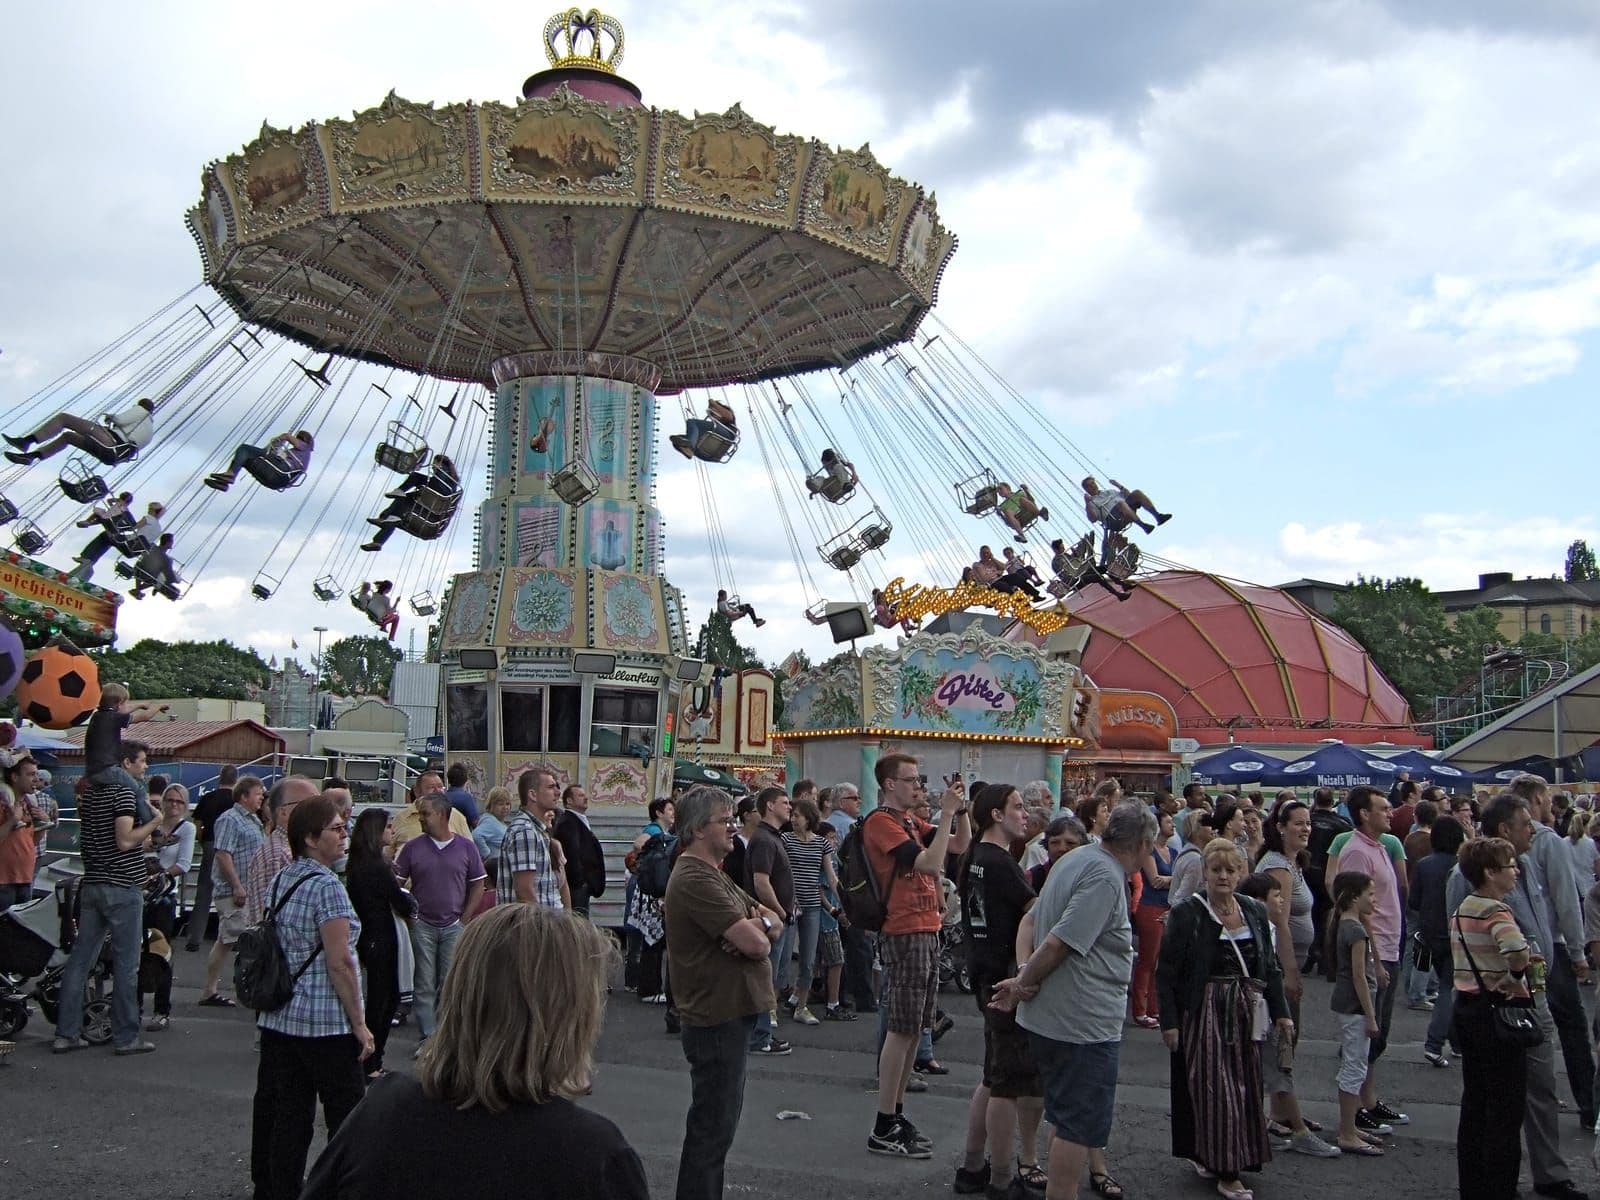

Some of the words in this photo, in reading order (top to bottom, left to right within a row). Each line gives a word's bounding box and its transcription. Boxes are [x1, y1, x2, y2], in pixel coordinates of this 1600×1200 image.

[1106, 705, 1166, 729] NÜSSE
[1317, 774, 1345, 787] Maisel's
[1345, 774, 1371, 786] Weisse
